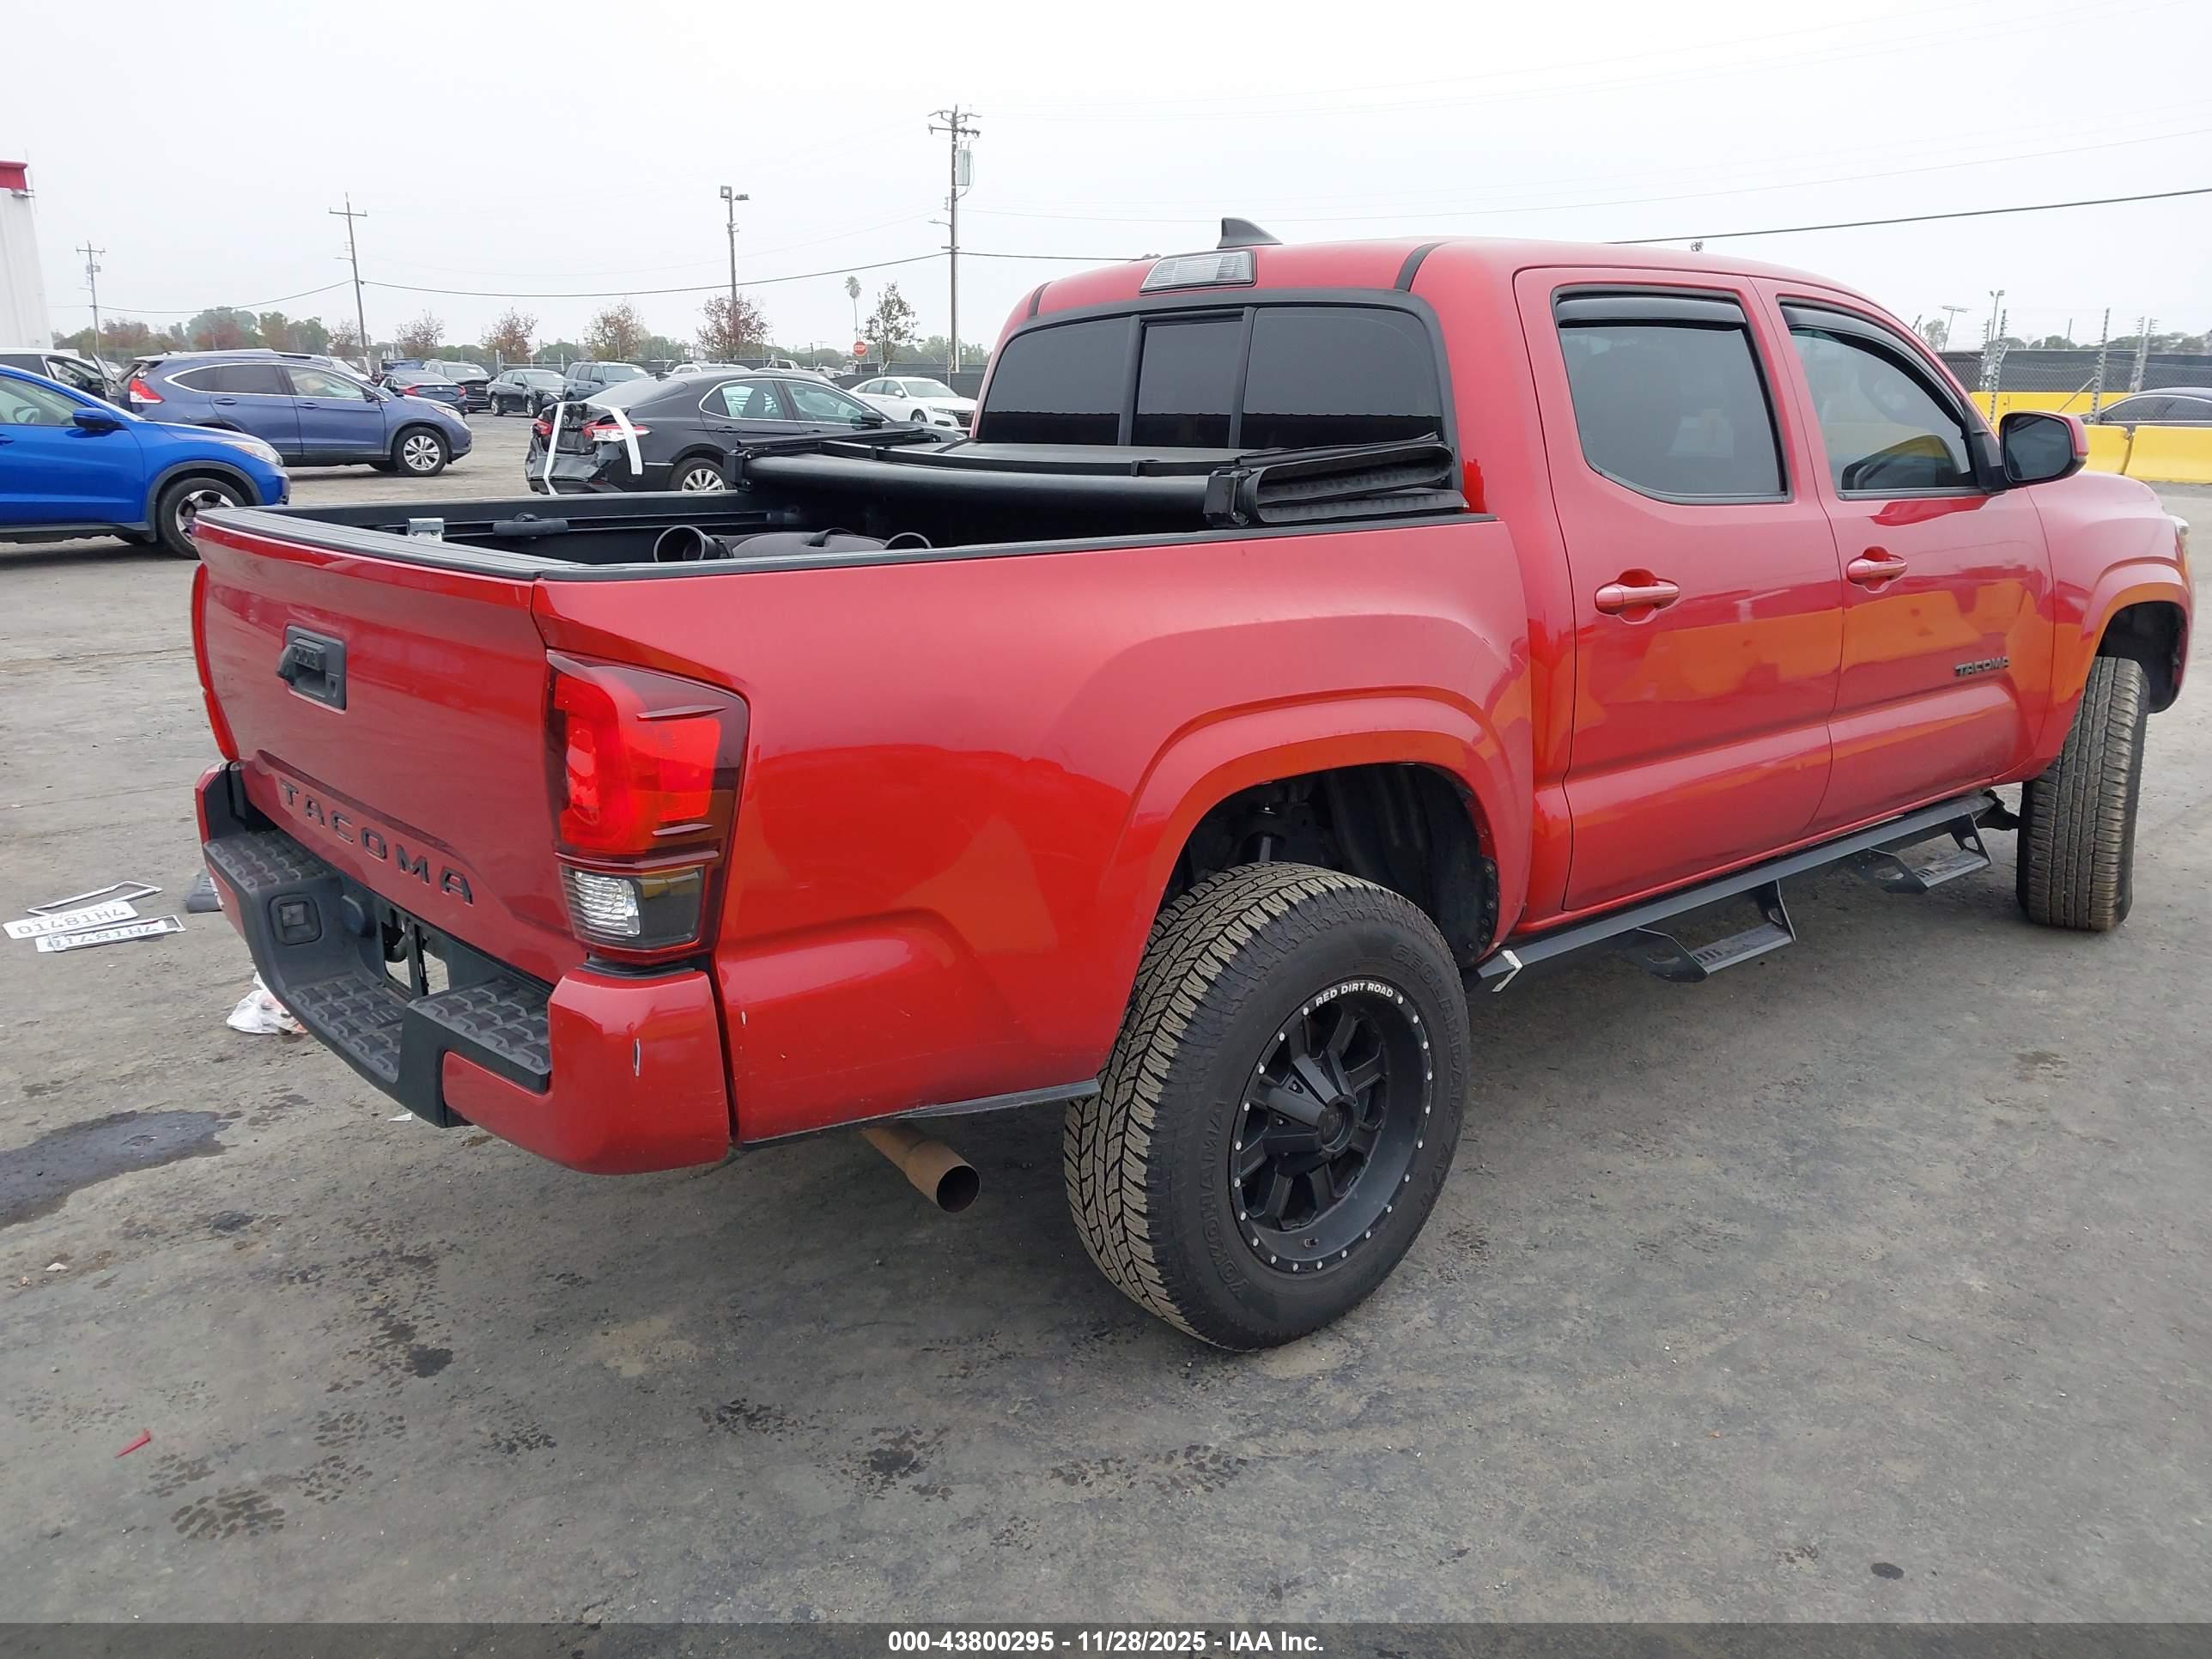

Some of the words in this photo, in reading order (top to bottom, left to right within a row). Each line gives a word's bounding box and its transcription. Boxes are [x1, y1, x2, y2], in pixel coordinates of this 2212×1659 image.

[1954, 656, 2009, 677] TACOMA
[280, 777, 474, 907] TACOMA
[1316, 989, 1338, 1006] RED
[1340, 982, 1365, 994] DIRT
[1367, 982, 1394, 998] ROAD
